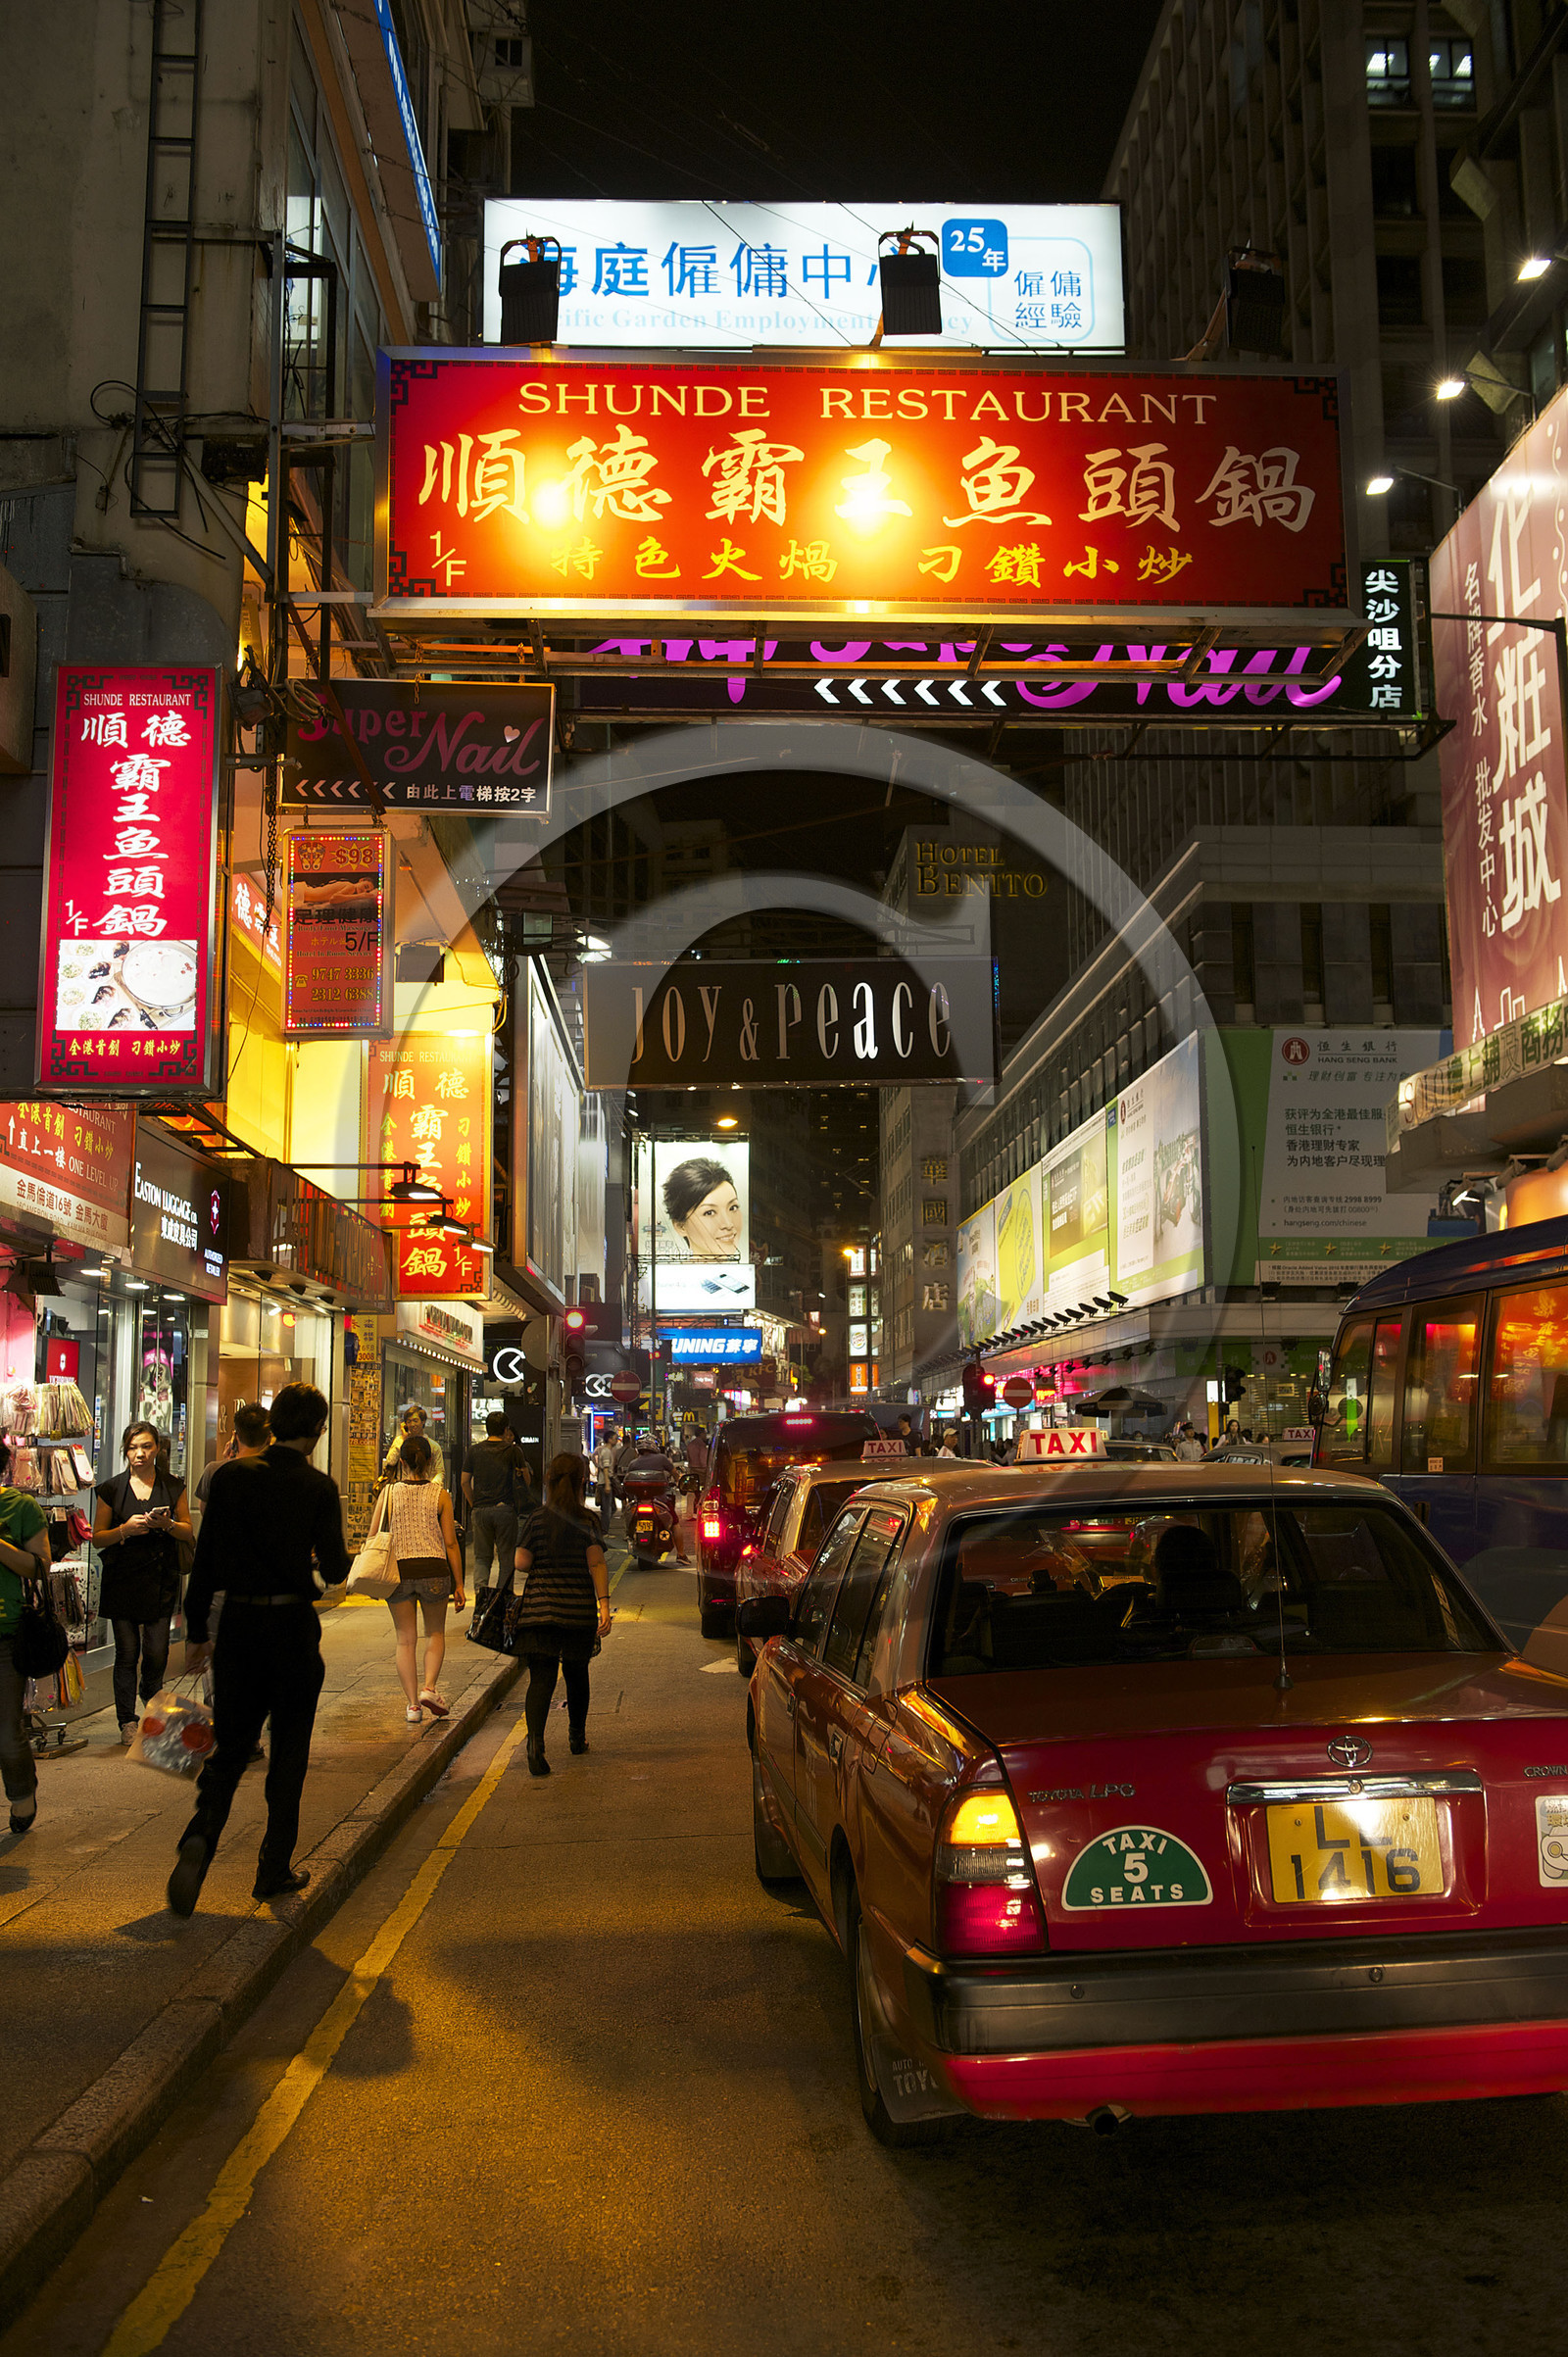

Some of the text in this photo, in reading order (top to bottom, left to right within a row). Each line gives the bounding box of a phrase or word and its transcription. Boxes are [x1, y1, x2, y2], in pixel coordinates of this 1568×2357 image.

[1014, 270, 1083, 298] 僱傭
[612, 309, 707, 329] Garden
[1014, 301, 1083, 329] 經驗
[518, 382, 1217, 426] SHUNDE RESTAURANT
[428, 530, 468, 588] 1/F
[1364, 568, 1403, 710] 尖沙咀分店
[83, 693, 192, 707] SHUNDE RESTAURANT
[80, 710, 192, 749] 順德
[383, 711, 547, 776] Nail
[406, 783, 537, 803] 由此上電梯按2字
[92, 753, 172, 938] 霸王魚頭鍋
[334, 847, 375, 866] $98
[915, 841, 1005, 865] HOTEL
[915, 863, 1049, 899] BENITO
[65, 899, 89, 937] 1/F
[311, 966, 374, 981] 9747 3336
[311, 987, 374, 1002] 2312 6388
[739, 997, 760, 1061] &
[379, 1050, 415, 1063] SHUNDE
[382, 1066, 470, 1101] 順德
[1285, 1107, 1387, 1121] 获评为全港最佳服
[1286, 1139, 1360, 1153] 香港理财专家
[68, 1155, 84, 1177] ONE
[85, 1164, 107, 1188] LEVEL
[109, 1176, 119, 1192] UP
[134, 1161, 162, 1208] EASTON
[1284, 1219, 1368, 1228] hangseng.com/chinese
[454, 1246, 473, 1277] 1/F
[748, 1362, 775, 1377] KFC
[867, 1442, 903, 1454] TAXI
[1029, 1431, 1100, 1455] TAXI
[1028, 1783, 1136, 1803] TOYOTA LPG
[1102, 1831, 1168, 1856] TAXI
[1123, 1852, 1149, 1884] 5
[1291, 1847, 1421, 1900] 1416
[1090, 1883, 1185, 1904] SEATS
